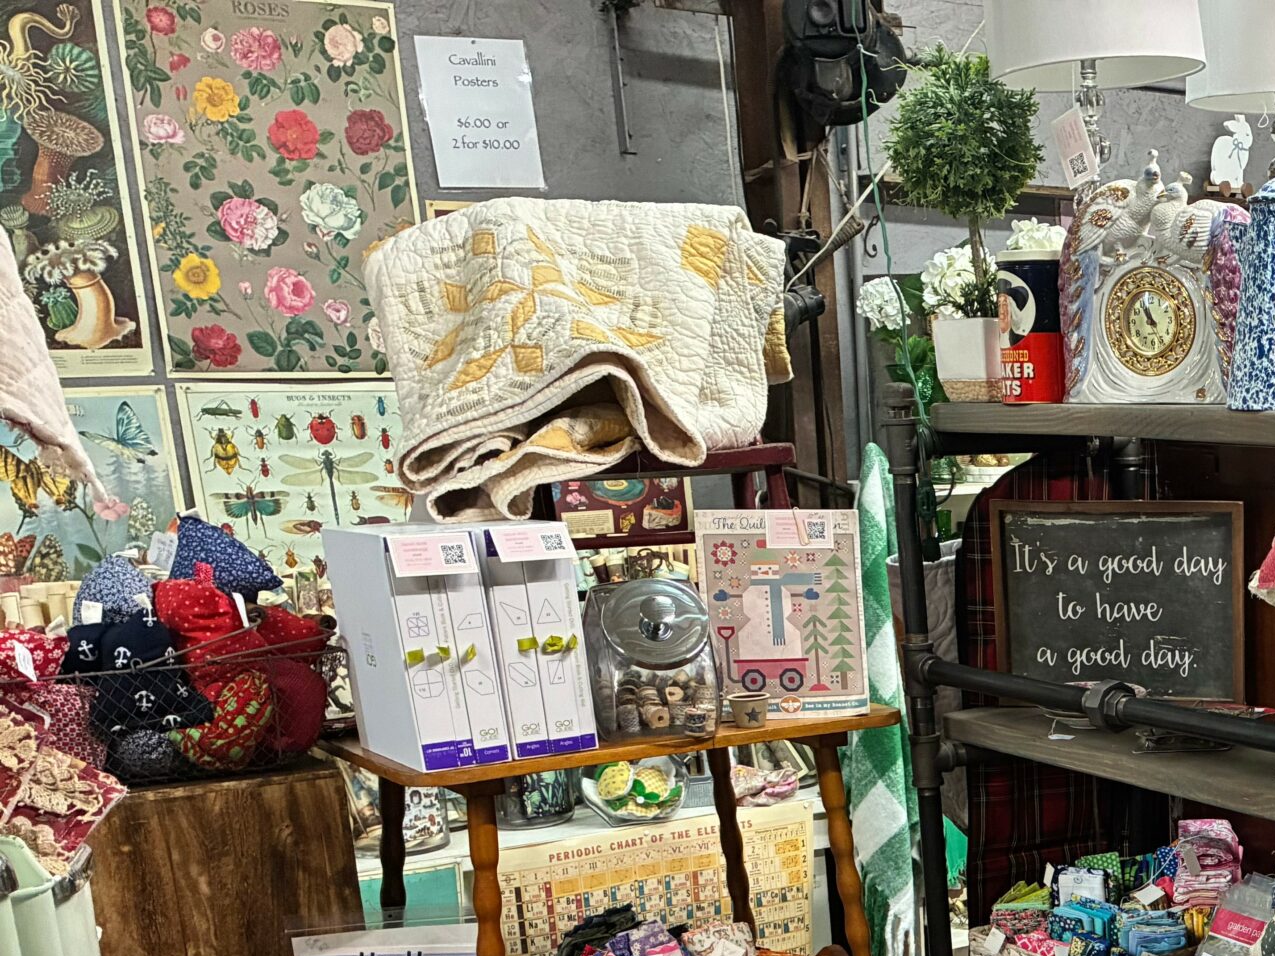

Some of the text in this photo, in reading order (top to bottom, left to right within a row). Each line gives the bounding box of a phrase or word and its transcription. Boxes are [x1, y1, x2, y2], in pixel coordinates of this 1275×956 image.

[231, 0, 290, 17] ROSES
[448, 52, 497, 66] Cavallini
[453, 75, 499, 88] Posters
[457, 116, 510, 129] $6.00 or
[452, 135, 521, 150] 2 for $10.00
[1001, 362, 1034, 378] AKER
[1002, 380, 1021, 396] ATS
[712, 517, 736, 530] The
[1010, 541, 1228, 586] It's a good day
[1056, 591, 1163, 623] to have
[1036, 638, 1198, 678] a good day.
[521, 722, 541, 732] GO!
[555, 719, 574, 729] GO!
[480, 727, 499, 737] GO!
[549, 819, 753, 863] PERIODIC CHART OF THE ELETS
[802, 854, 807, 863] 2
[803, 870, 808, 879] 3
[1227, 921, 1252, 935] garden
